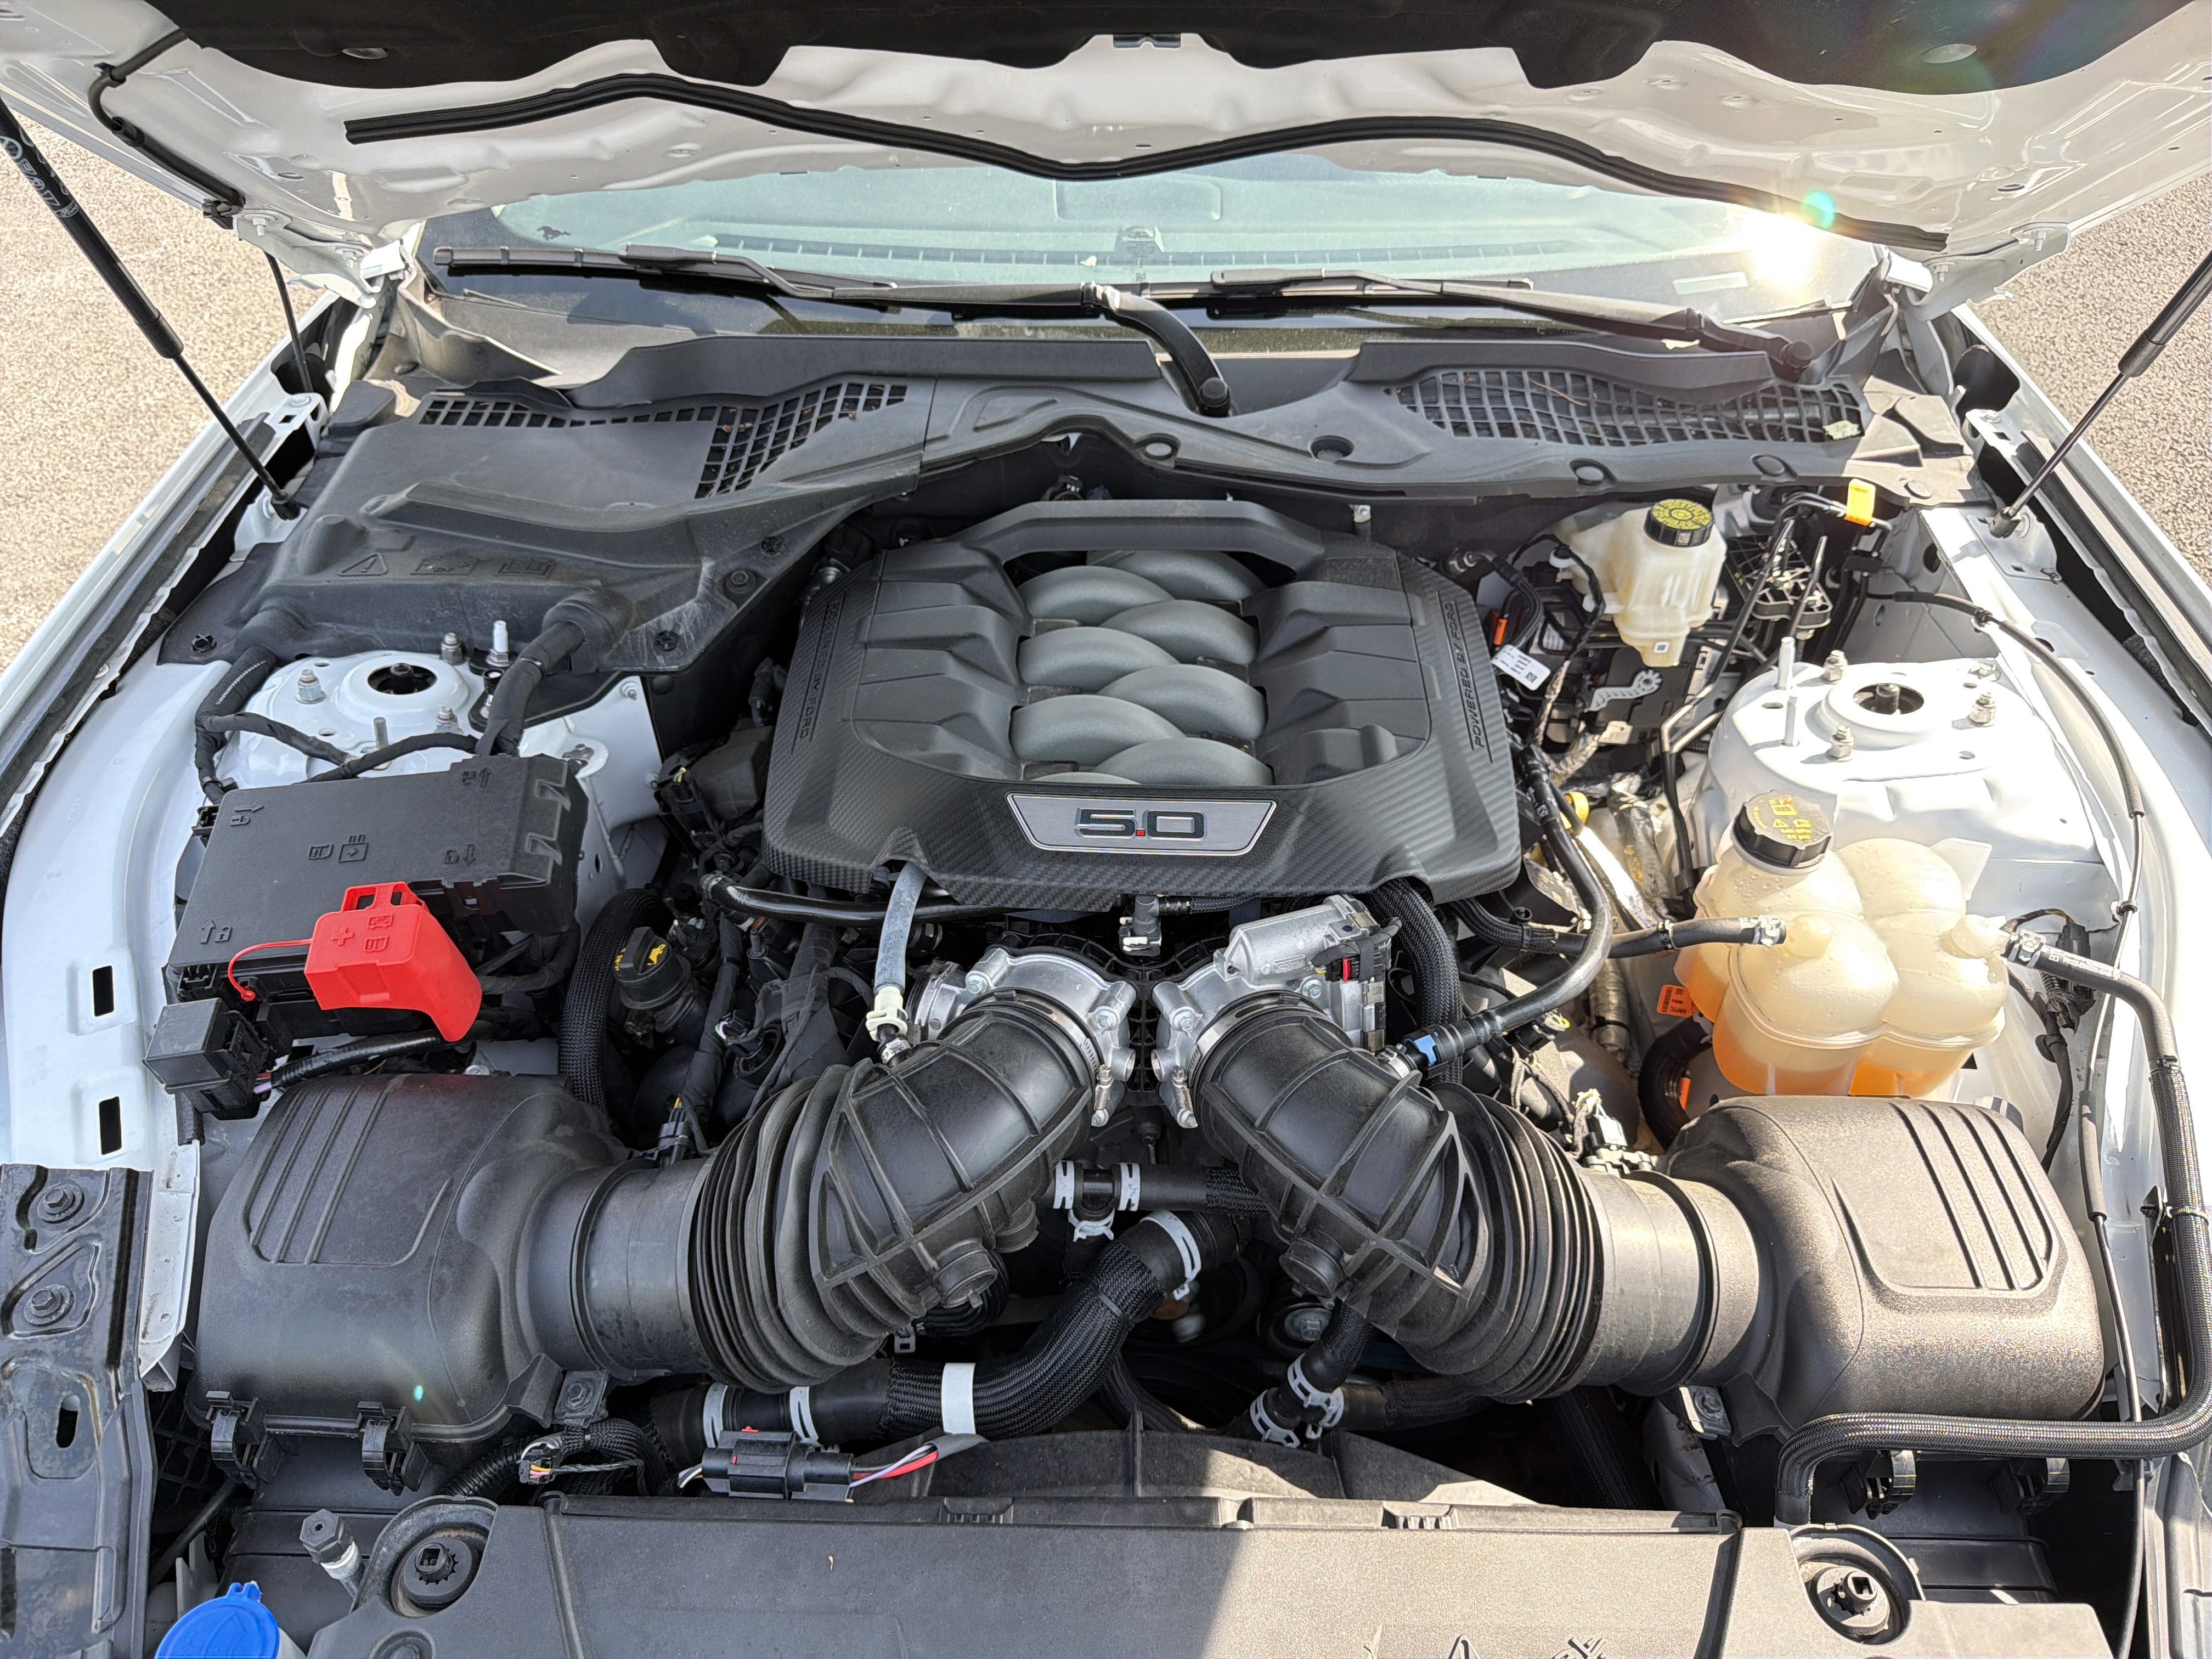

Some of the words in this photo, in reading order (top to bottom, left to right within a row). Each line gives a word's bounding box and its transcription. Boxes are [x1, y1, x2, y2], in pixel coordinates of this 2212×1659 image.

[1444, 602, 1460, 640] FORD
[1454, 644, 1465, 663] BY
[812, 674, 821, 691] BY
[800, 696, 816, 738] FORD
[1460, 669, 1484, 748] POWERED
[1074, 807, 1207, 842] 5.0
